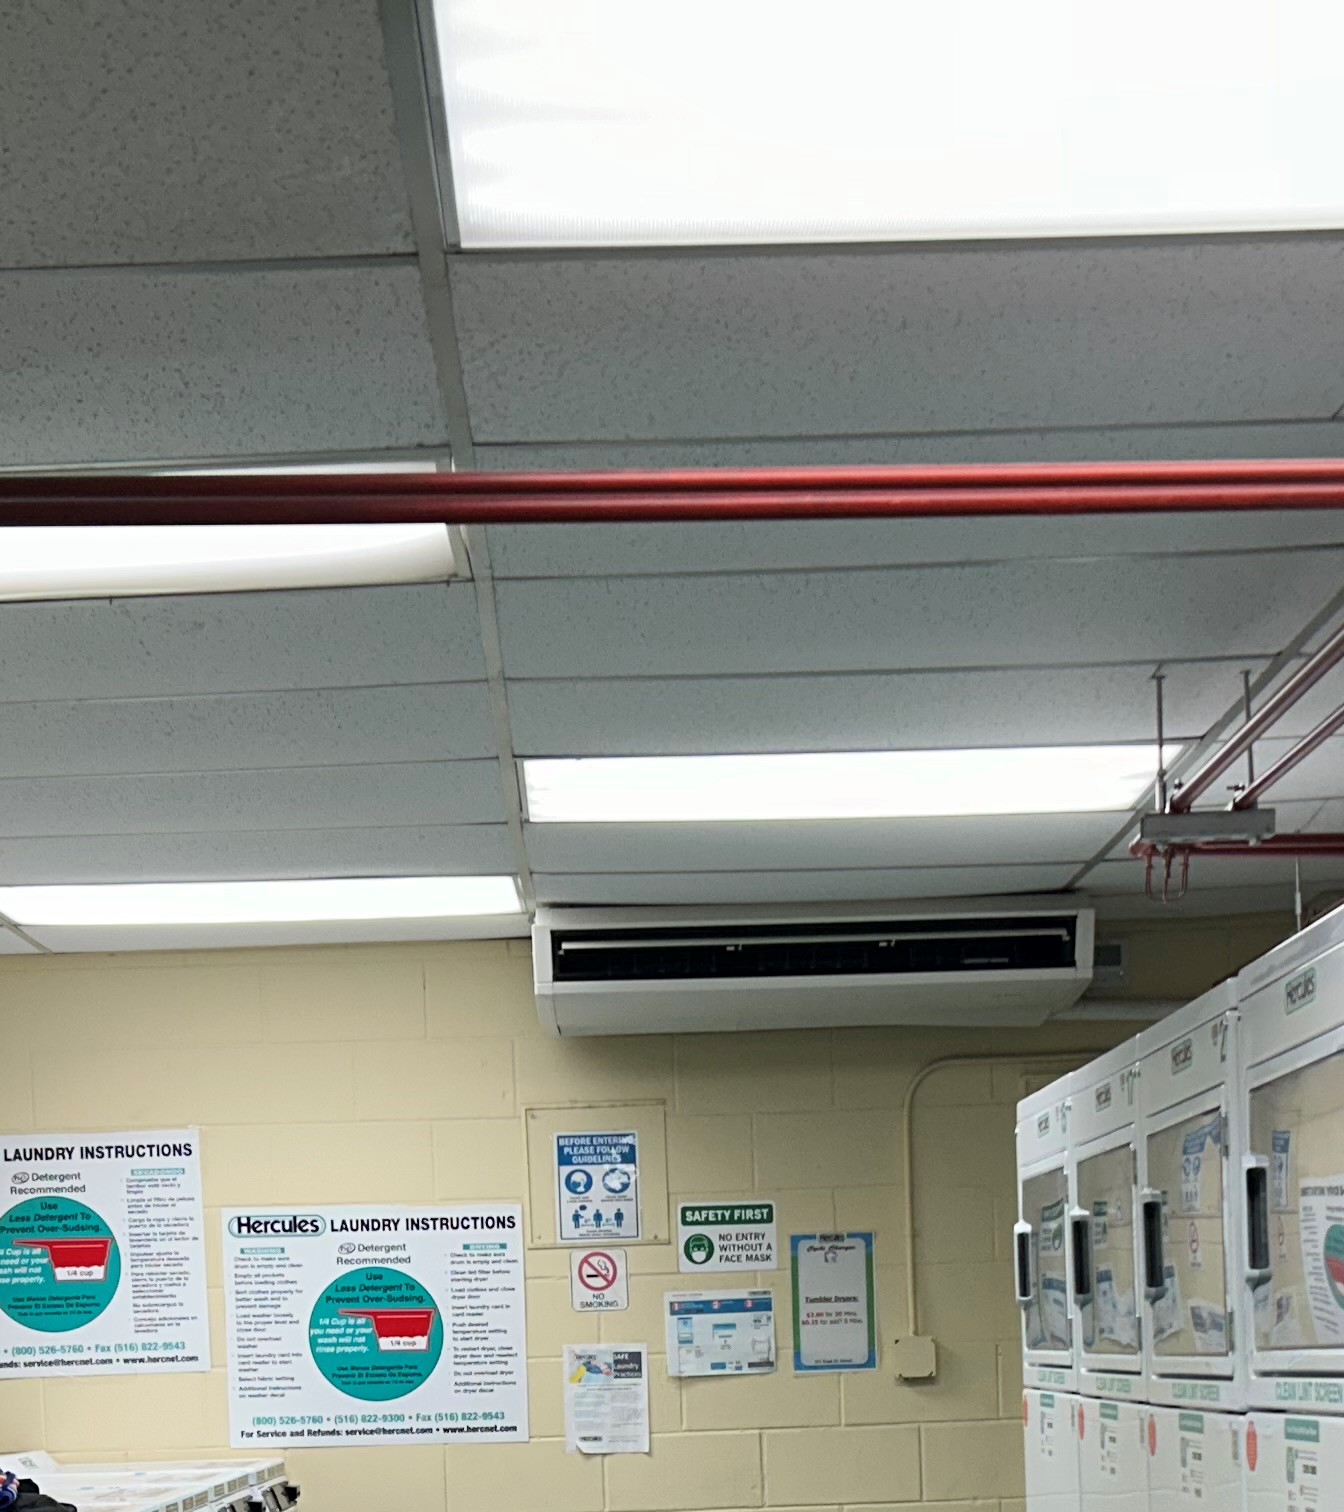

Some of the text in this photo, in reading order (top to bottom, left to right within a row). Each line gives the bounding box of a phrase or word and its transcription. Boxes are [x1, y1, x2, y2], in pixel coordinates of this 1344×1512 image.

[1287, 976, 1315, 1004] Hercules
[559, 1137, 591, 1146] BEFORE
[3, 1146, 75, 1162] LAUNDRY
[80, 1143, 193, 1160] INSTRUCTIONS
[563, 1146, 595, 1155] PLEASE
[31, 1171, 81, 1184] Detergent
[10, 1184, 86, 1196] Recommended
[40, 1202, 58, 1210] Use
[9, 1212, 92, 1224] Less Detergent To
[685, 1208, 769, 1222] SAFETY FIRST
[0, 1223, 103, 1234] Prevent Over-Sudsing.
[237, 1215, 516, 1234] Hercules LAUNDRY INSTRUCTIONS
[718, 1232, 766, 1242] NO ENTRY
[6, 1249, 22, 1257] Cup
[358, 1243, 406, 1254] Detergent
[718, 1243, 773, 1253] WITHOUT A
[31, 1258, 49, 1267] your
[336, 1256, 411, 1266] Recommended
[719, 1253, 772, 1263] FACE MASK
[14, 1266, 28, 1274] will
[80, 1270, 94, 1278] cup
[366, 1273, 384, 1281] Use
[335, 1282, 416, 1293] Less Detergent To
[325, 1296, 360, 1304] Prevent
[580, 1300, 619, 1308] SMOKING
[331, 1318, 347, 1326] Cup
[310, 1328, 325, 1337] you
[326, 1327, 345, 1335] need
[355, 1327, 373, 1336] your
[317, 1336, 338, 1344] wash
[11, 1346, 36, 1357] (800)
[39, 1344, 84, 1355] 526-5760
[95, 1343, 111, 1353] Fax
[114, 1342, 138, 1354] (516)
[141, 1341, 186, 1352] 822-9543
[23, 1357, 113, 1369] service@hercnet.com
[123, 1355, 199, 1364] www.hercnet.com
[1275, 1382, 1343, 1404] CLEAN LINT SCREEN
[252, 1411, 505, 1428] (800) 526-5760 (516) 822-9300 Fax (516) 822-9543
[241, 1424, 518, 1438] For Service and Refunds: service@hercnet.com www.hercnet.com
